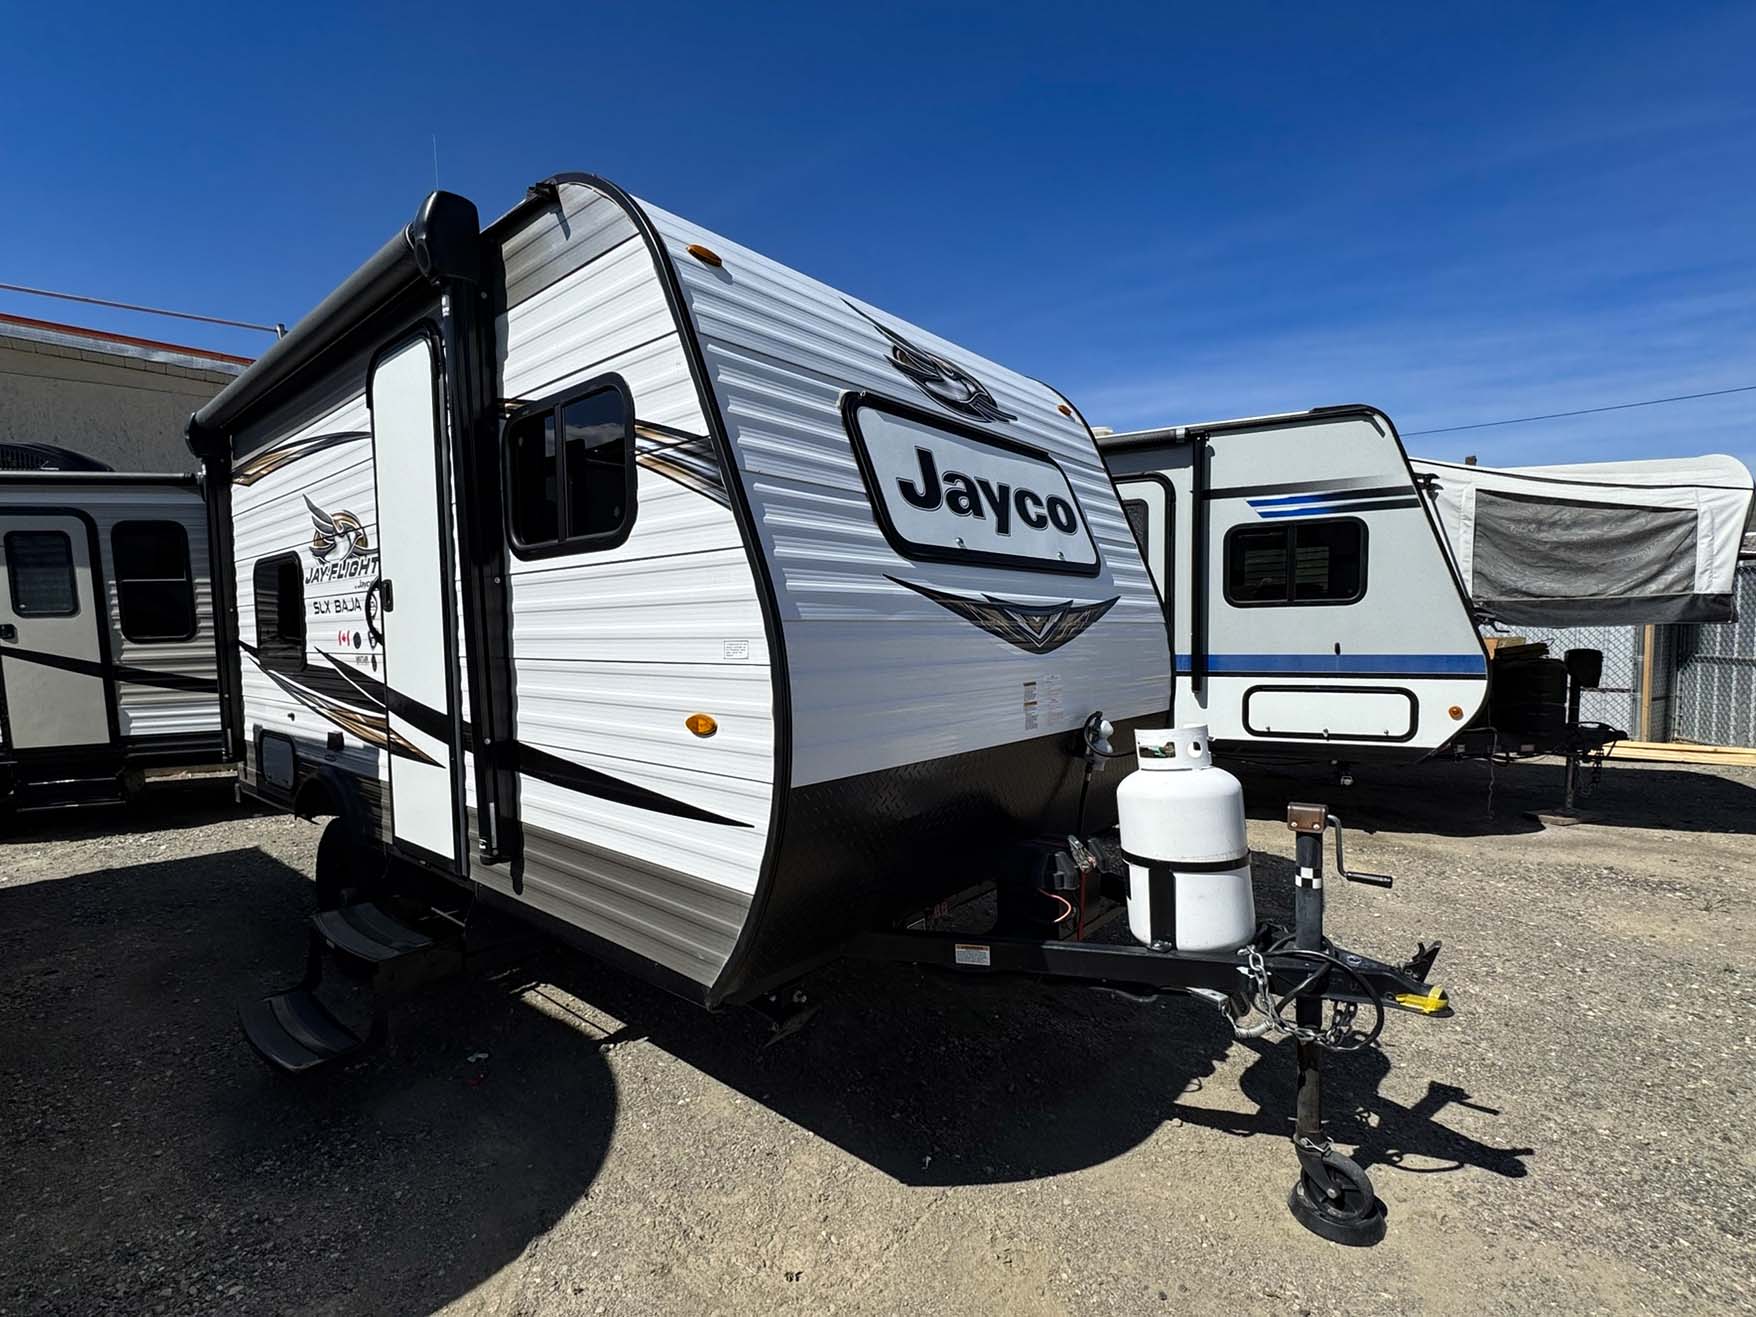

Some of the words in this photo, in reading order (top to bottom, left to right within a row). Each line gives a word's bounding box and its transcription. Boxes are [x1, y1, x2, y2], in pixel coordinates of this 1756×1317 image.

[896, 445, 1078, 536] Jayco
[305, 566, 328, 585] JAY
[329, 556, 379, 581] FLIGHT
[313, 600, 331, 615] SLX
[334, 597, 362, 613] BAJA
